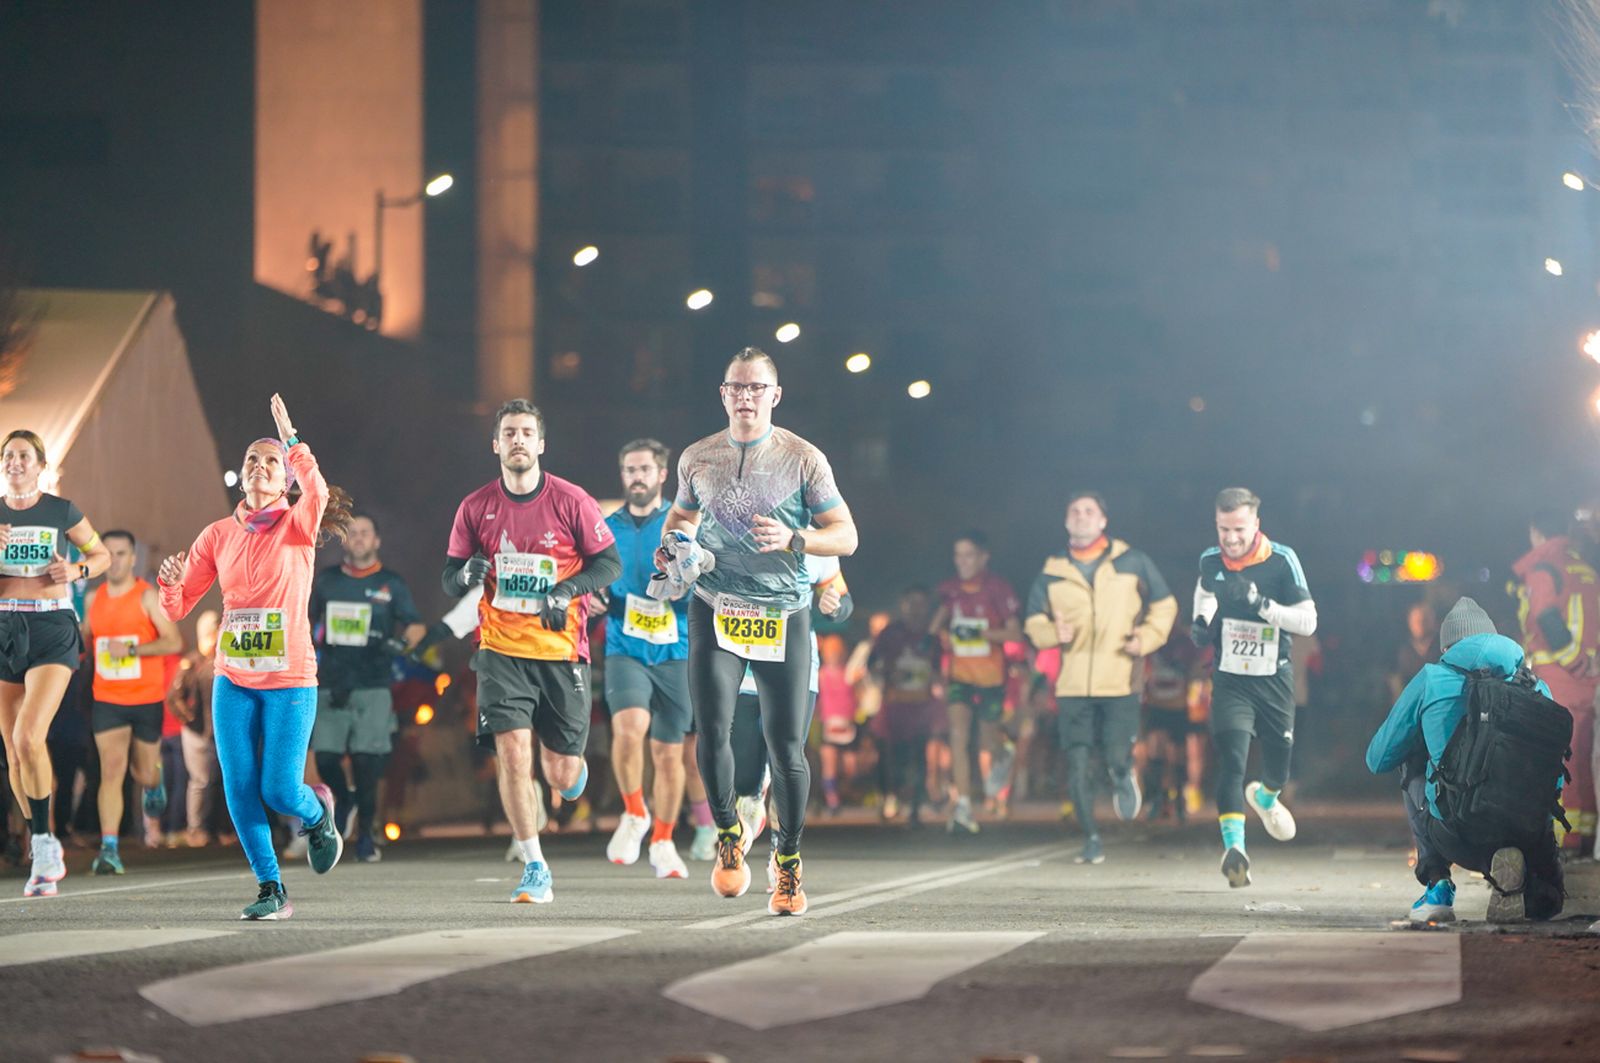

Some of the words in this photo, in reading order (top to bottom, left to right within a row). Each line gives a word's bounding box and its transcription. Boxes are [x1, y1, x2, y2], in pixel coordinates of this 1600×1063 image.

[5, 544, 49, 560] 13953
[505, 574, 549, 594] 13520
[722, 608, 735, 616] SAN
[722, 617, 777, 639] 12336
[230, 632, 273, 651] 4647
[1232, 639, 1265, 657] 2221
